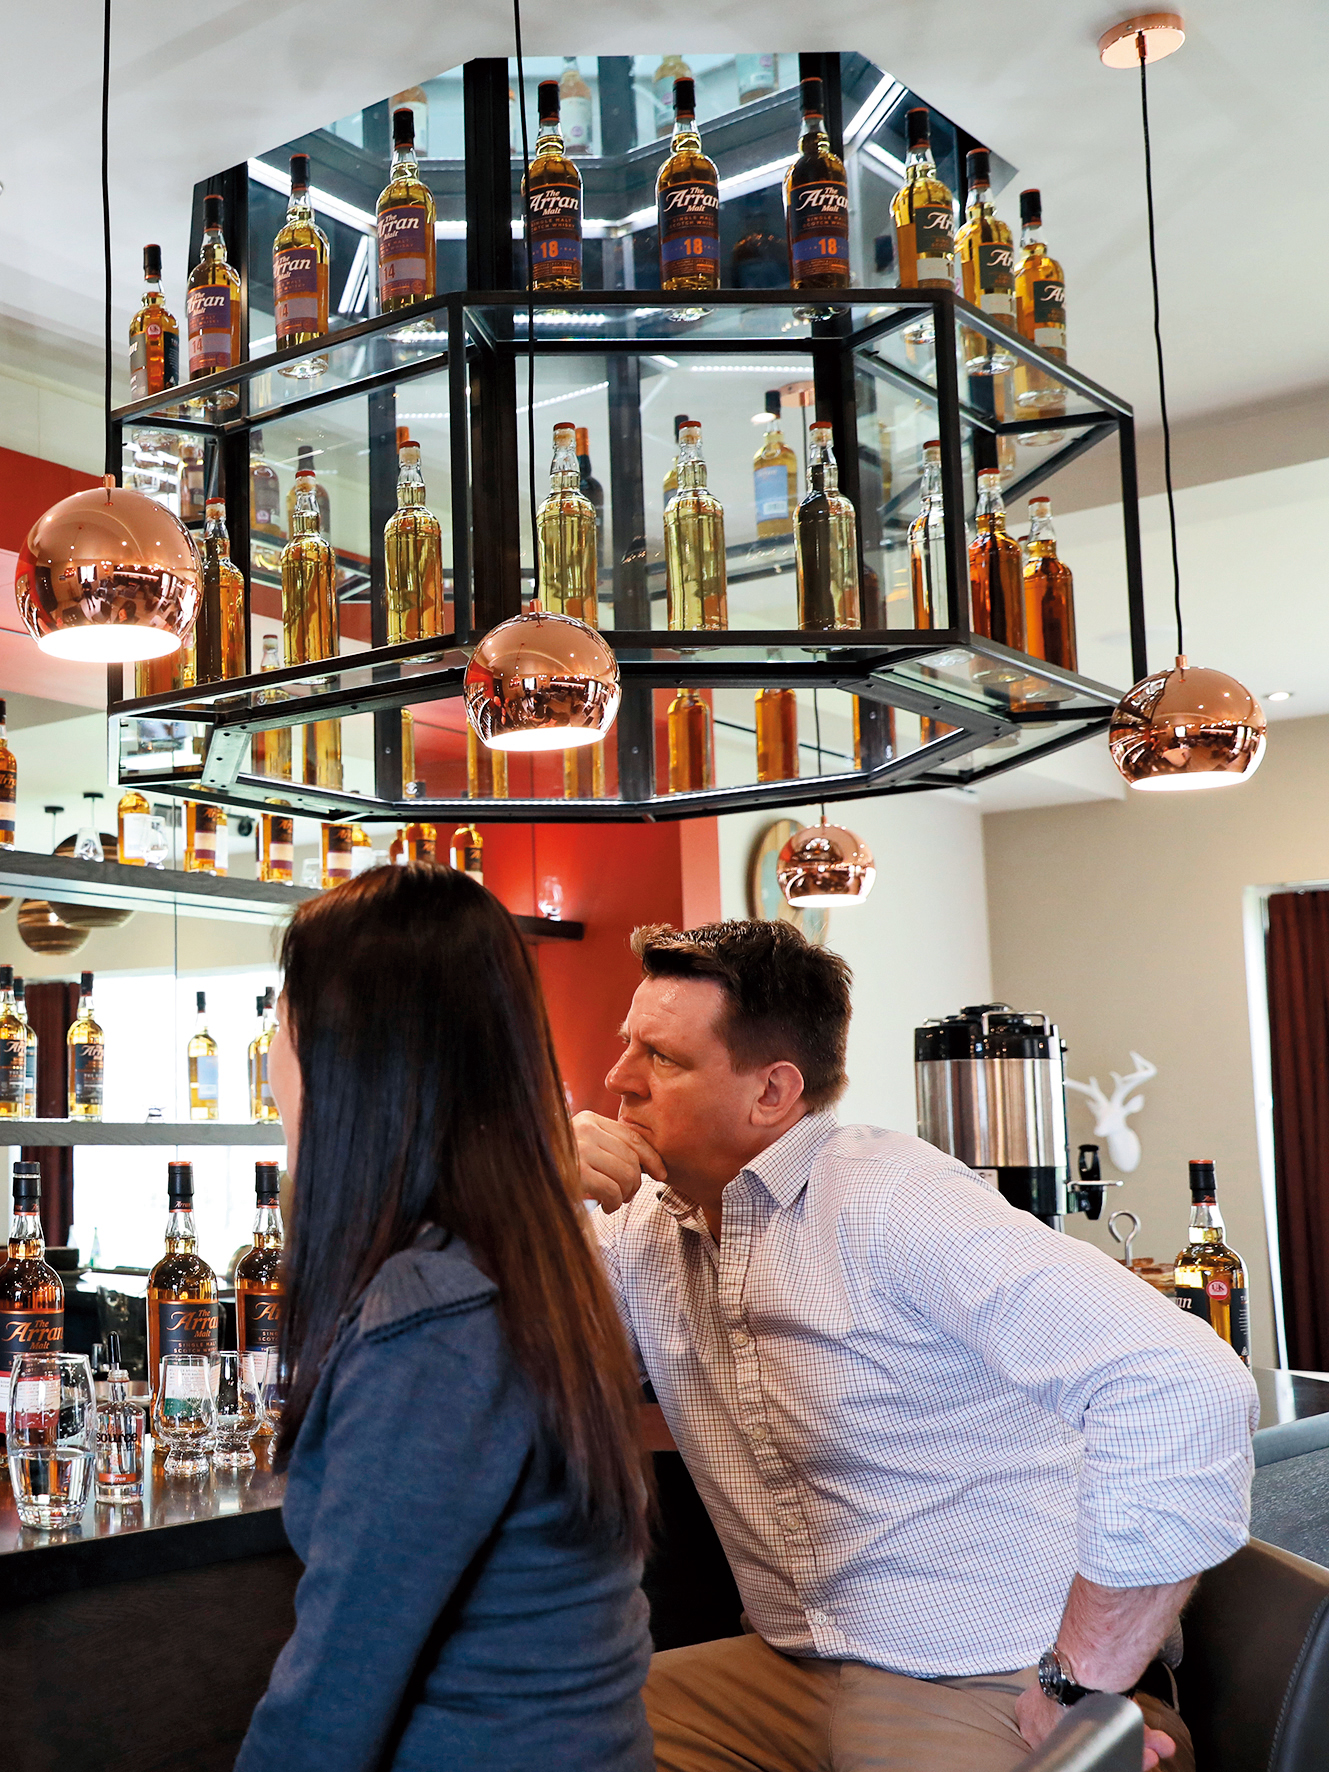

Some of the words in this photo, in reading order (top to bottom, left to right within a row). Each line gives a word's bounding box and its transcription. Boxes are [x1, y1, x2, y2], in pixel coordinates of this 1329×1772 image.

[690, 186, 704, 194] The
[824, 186, 838, 194] The
[529, 192, 579, 212] Arran
[663, 188, 719, 212] Arran
[386, 214, 398, 222] The
[540, 240, 559, 258] 18
[684, 238, 703, 255] 18
[818, 238, 837, 254] 18
[383, 264, 395, 280] 14
[192, 337, 203, 353] 14
[198, 1309, 211, 1317] The
[35, 1320, 50, 1328] The
[166, 1310, 219, 1331] Arra
[194, 1329, 212, 1338] Malt
[30, 1341, 50, 1350] Malt
[96, 1432, 138, 1443] source
